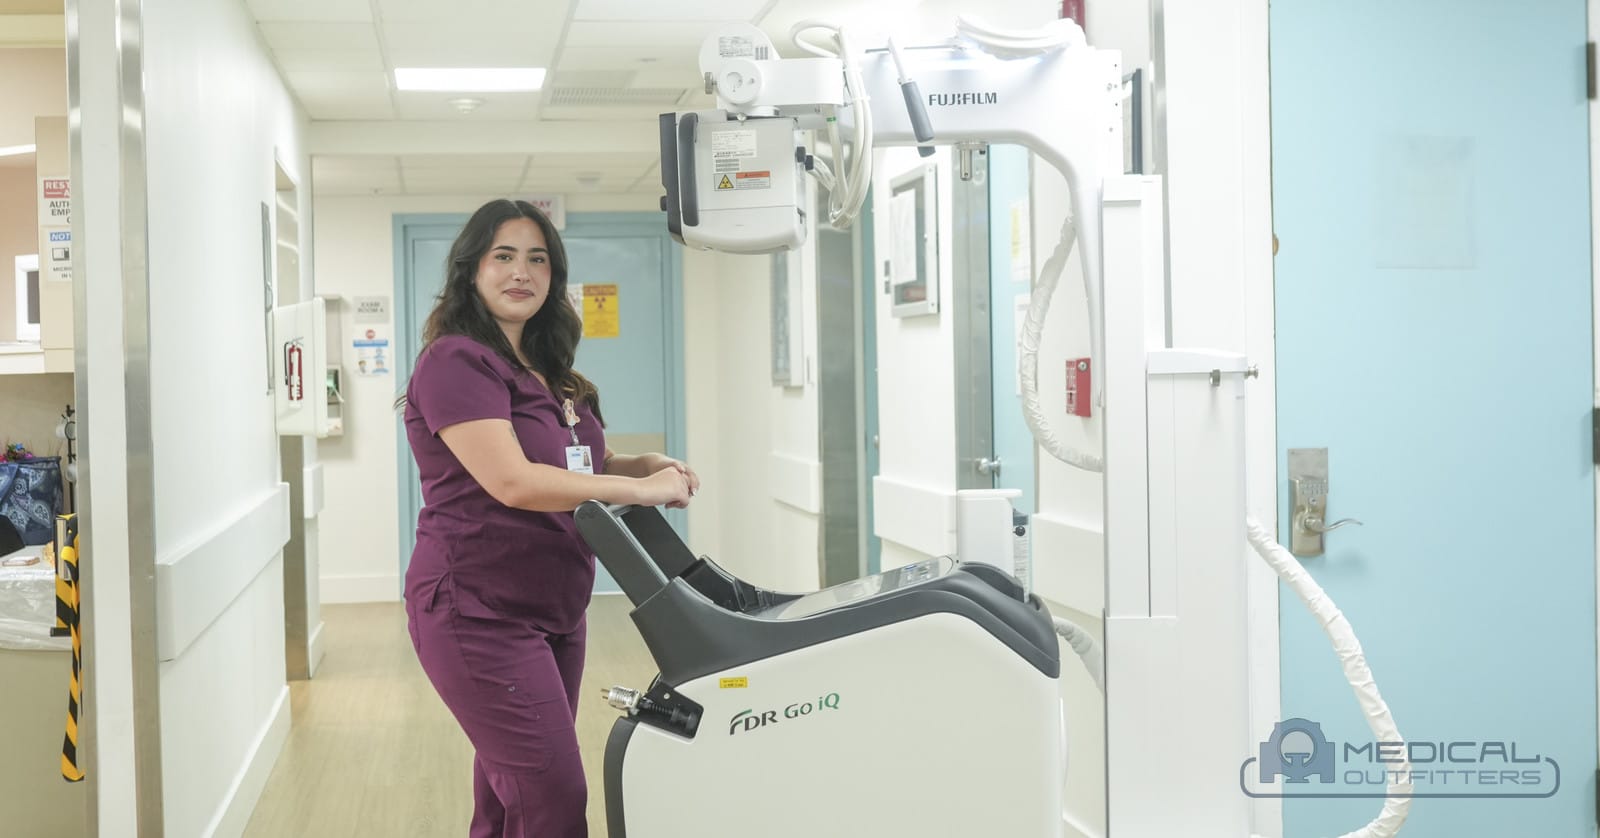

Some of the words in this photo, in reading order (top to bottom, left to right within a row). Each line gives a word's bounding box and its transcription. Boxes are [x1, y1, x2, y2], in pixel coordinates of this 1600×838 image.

[929, 92, 997, 106] FUJIFILM
[729, 708, 778, 735] FDR
[818, 692, 840, 711] iQ
